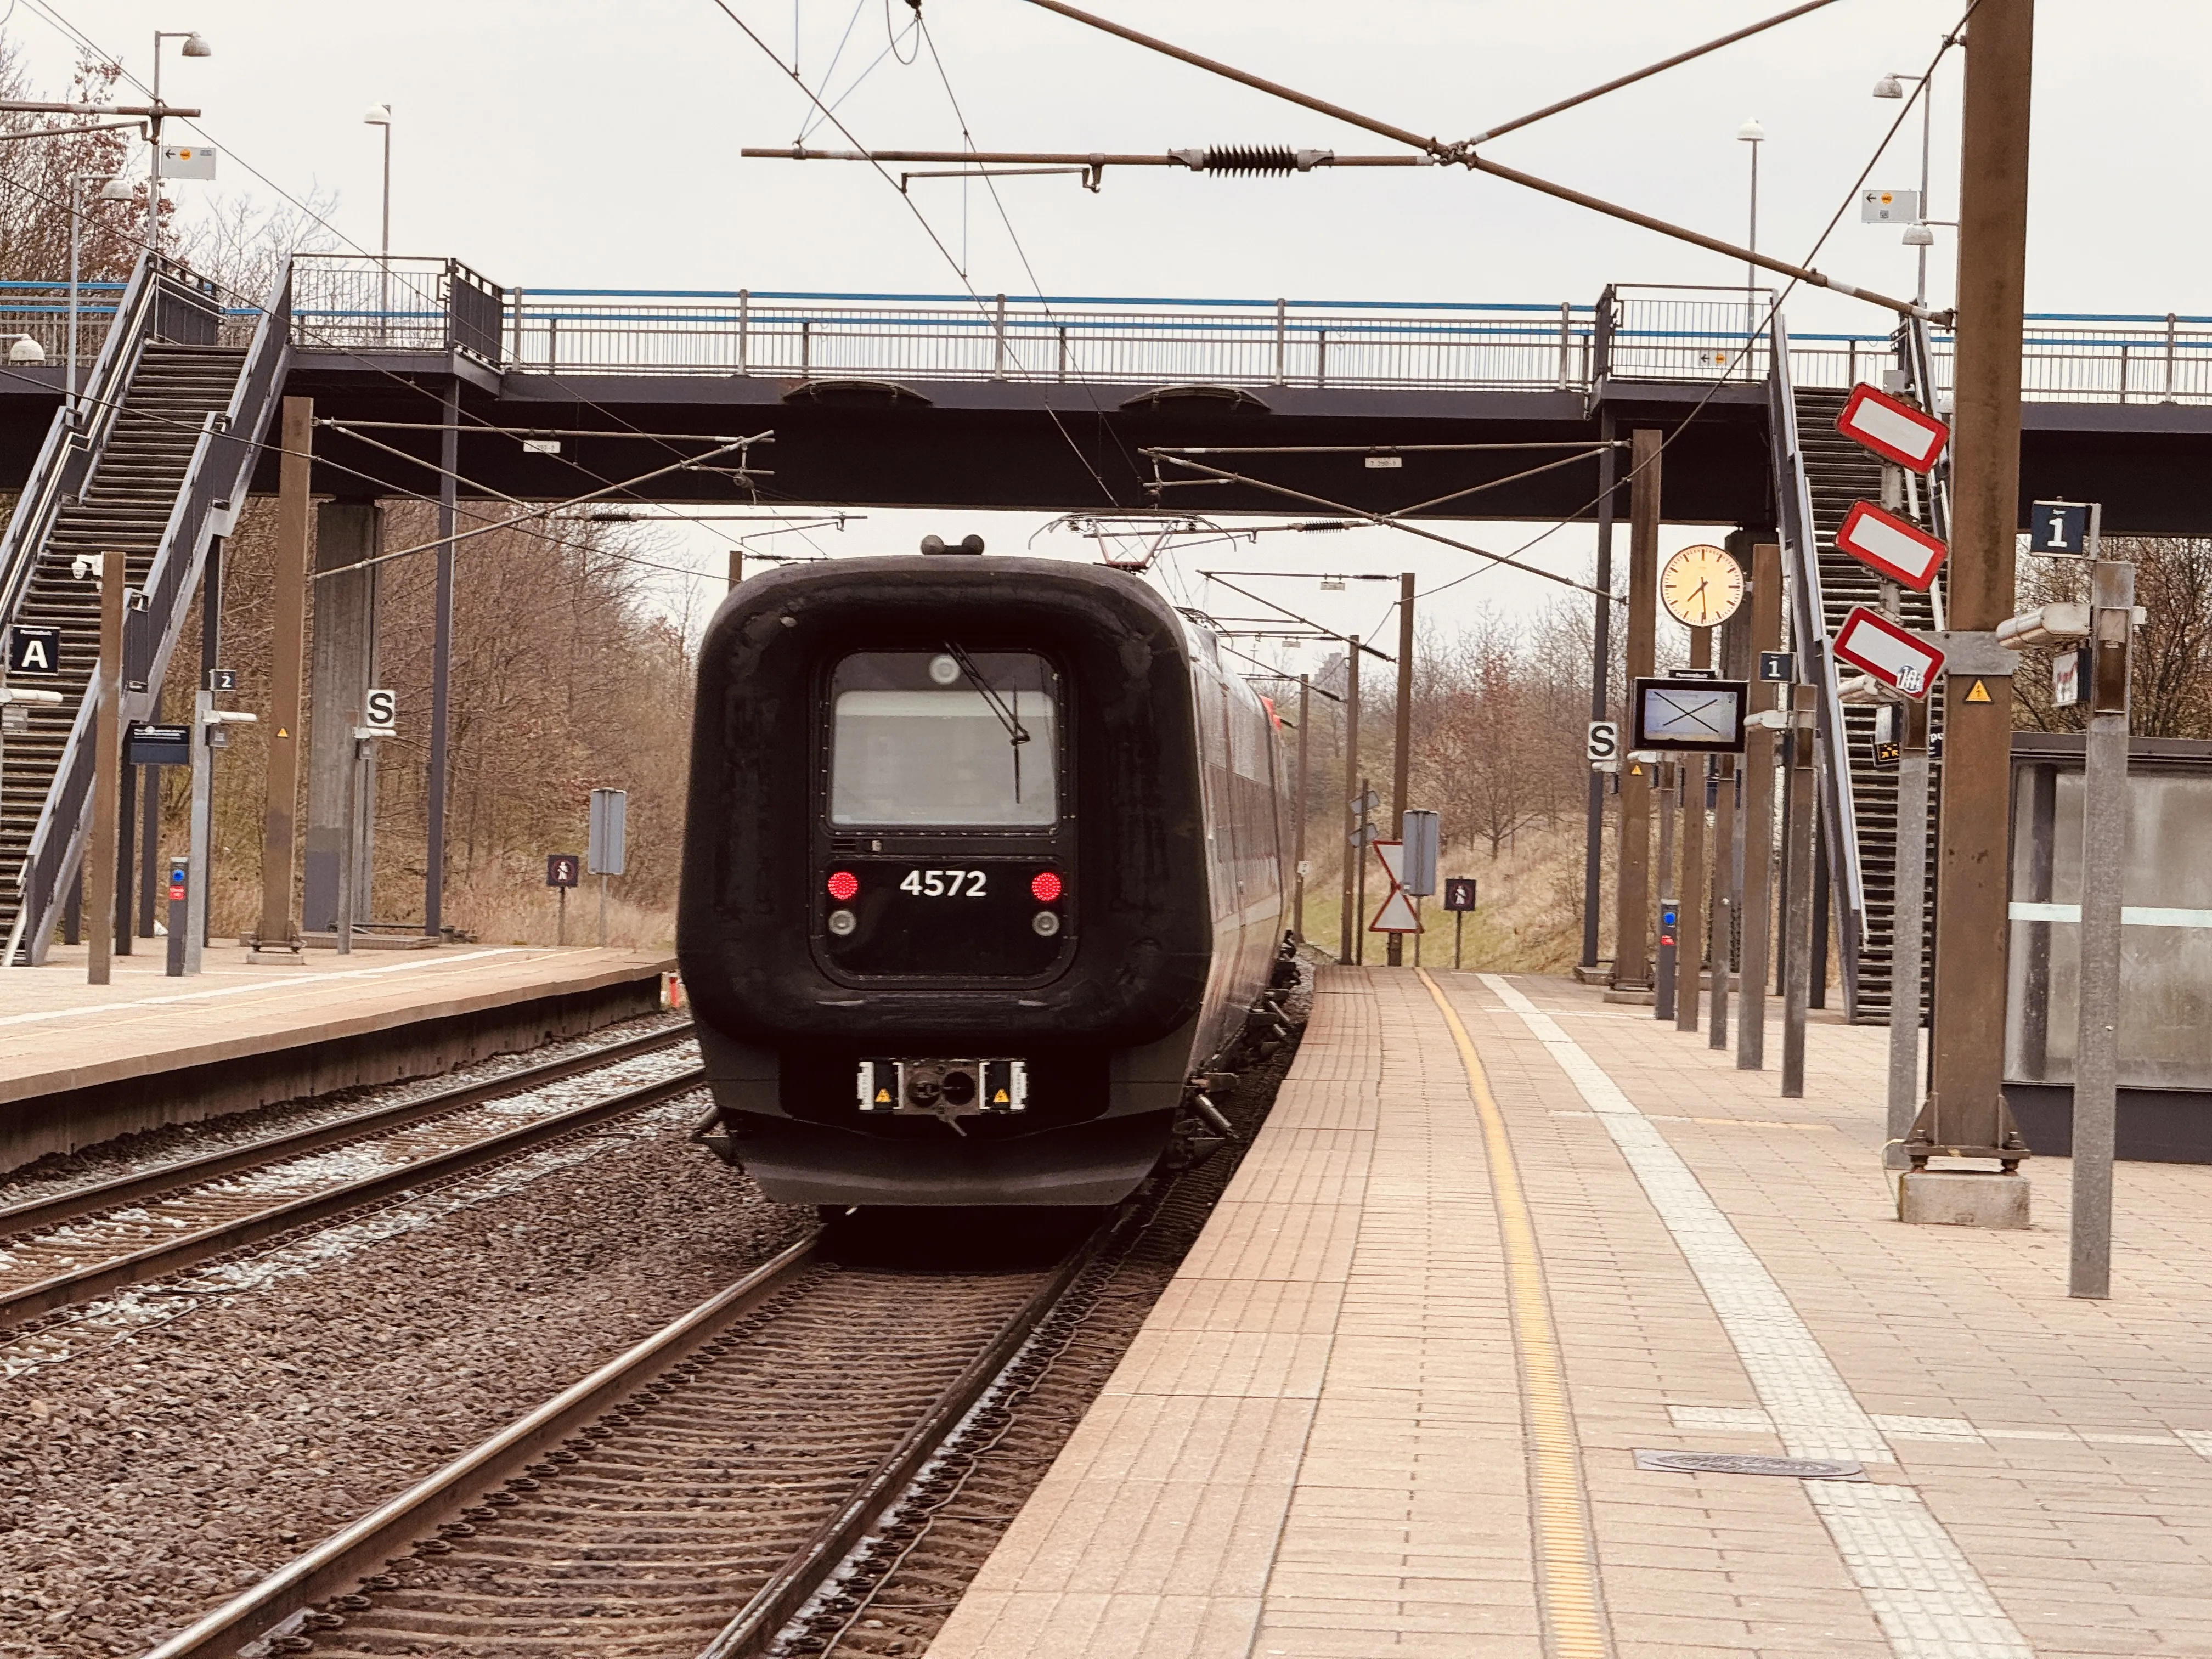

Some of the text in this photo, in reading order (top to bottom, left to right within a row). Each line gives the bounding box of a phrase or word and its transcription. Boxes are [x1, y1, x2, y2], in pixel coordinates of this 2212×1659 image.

[2047, 518, 2067, 547] 1
[21, 640, 48, 668] A
[221, 675, 232, 687] 2
[1768, 661, 1781, 677] 1
[368, 693, 393, 724] S
[1590, 725, 1615, 757] S
[900, 870, 987, 896] 4572
